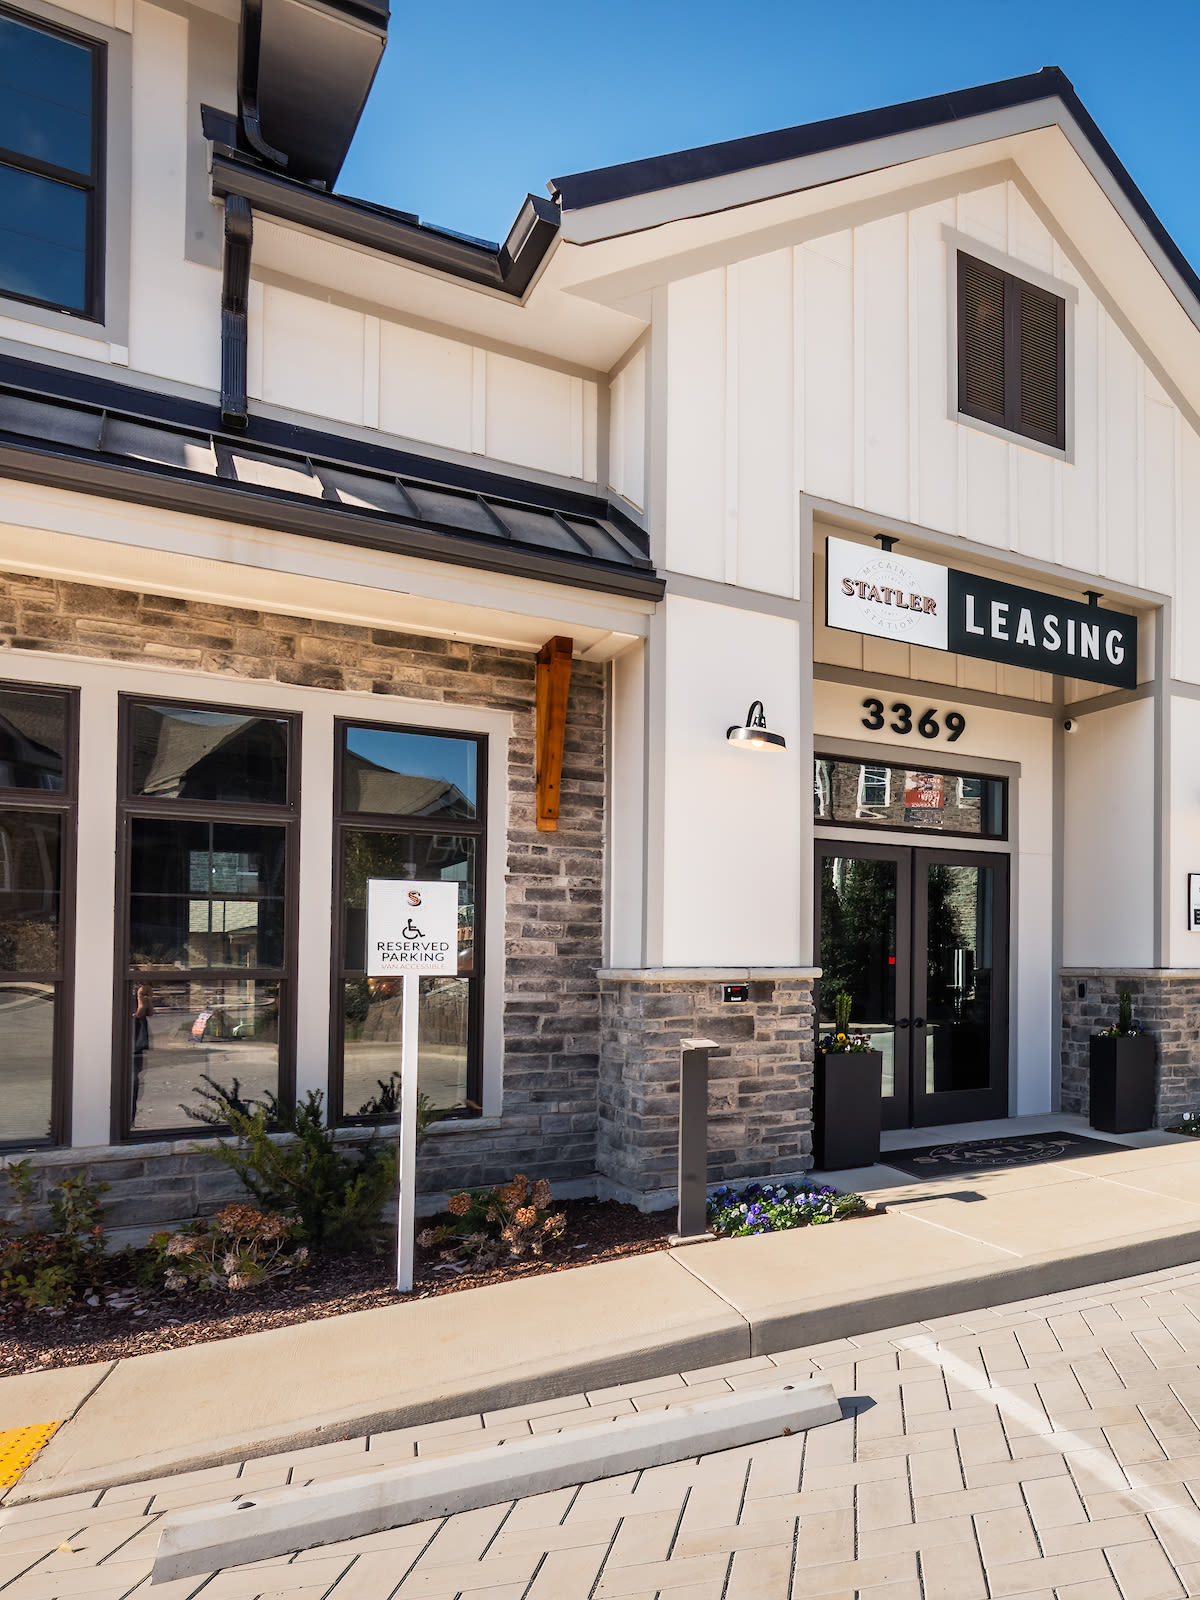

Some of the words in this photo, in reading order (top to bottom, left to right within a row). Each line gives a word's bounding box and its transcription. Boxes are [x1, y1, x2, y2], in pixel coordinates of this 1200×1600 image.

[840, 577, 938, 616] STATLER
[864, 608, 915, 630] STATION
[965, 594, 1125, 666] LEASING
[861, 698, 966, 742] 3369
[407, 890, 422, 907] S
[377, 942, 449, 951] RESERVED
[382, 952, 445, 962] PARKING
